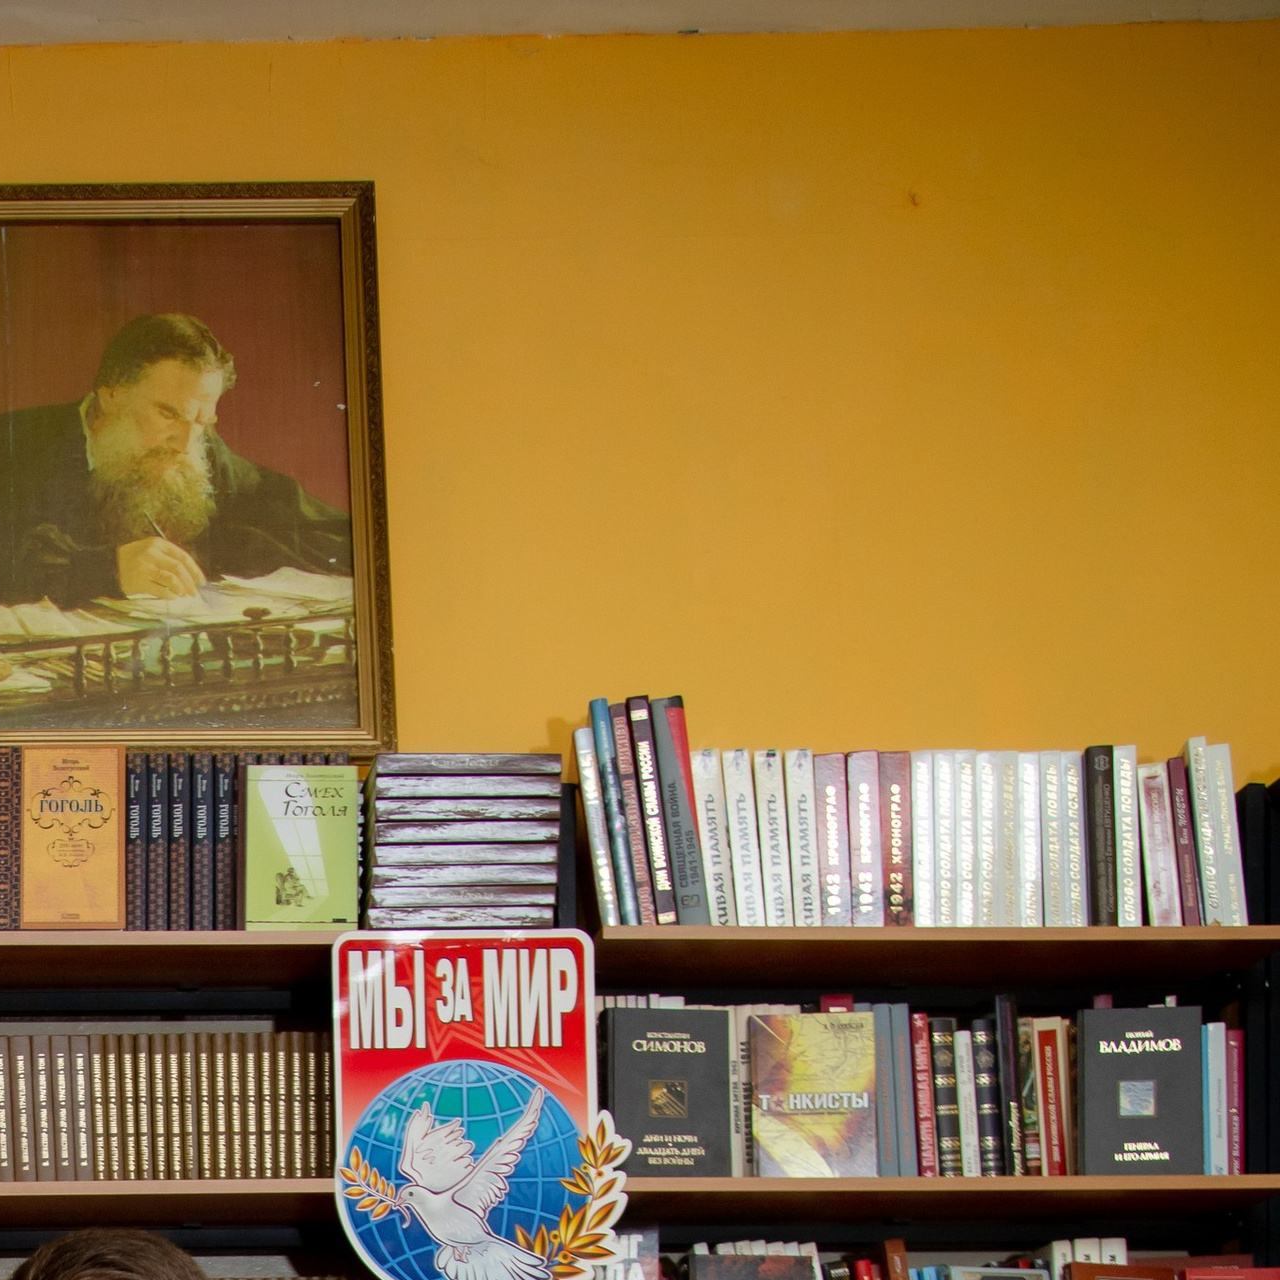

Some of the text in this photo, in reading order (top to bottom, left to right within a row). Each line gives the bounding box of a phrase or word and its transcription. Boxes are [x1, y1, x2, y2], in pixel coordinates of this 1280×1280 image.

[39, 799, 104, 813] ГОГОЛЬ
[638, 741, 672, 891] ДНИ ВОИНСКОЙ СЛАВЫ РОССИИ
[939, 761, 951, 817] ПОБЕДЫ
[961, 762, 973, 818] ПОБЕДЫ
[668, 782, 688, 888] СВЯЩЕННАЯ ВОЙНА
[685, 830, 700, 886] 1941-1945
[703, 794, 722, 866] ПАМЯТЬ
[735, 793, 753, 868] ПАМЯТЬ
[766, 794, 782, 866] ПАМЯТЬ
[795, 794, 812, 868] ПАМЯТЬ
[940, 818, 952, 878] СОЛДАТА
[962, 819, 974, 880] СОЛДАТА
[1121, 759, 1136, 922] СЛОВО СОЛДАТА ПОБЕДЫ
[826, 874, 842, 916] 1942
[858, 871, 874, 914] 1942
[890, 872, 904, 914] 1942
[347, 947, 579, 1050] МЫ ЗА МИР
[632, 1039, 706, 1054] СИМОНОВ
[1044, 1046, 1054, 1076] РОССИИ
[1099, 1039, 1182, 1054] ВЛАДИМОВ
[94, 1054, 105, 1171] ФРИДРИХ ШИЛЛЕР ИЗБРАННОЕ
[125, 1054, 135, 1171] ФРИДРИХ ШИЛЛЕР ИЗБРАННОЕ
[170, 1054, 180, 1171] ФРИДРИХ ШИЛЛЕР ИЗБРАННОЕ
[200, 1053, 211, 1169] ФРИДРИХ ШИЛЛЕР ИЗБРАННОЕ
[916, 1071, 932, 1118] ЖИВАЯ
[636, 1146, 705, 1157] ДВАДЦАТЬ ДНЕЙ
[643, 1134, 698, 1144] ДНИ И НОЧИ
[648, 1156, 694, 1166] БЕЗ ВОЙНЫ
[920, 1120, 934, 1167] ПАМЯТИ
[1124, 1142, 1160, 1150] ГЕНЕРАЛ
[1140, 1152, 1170, 1160] АРМИЯ
